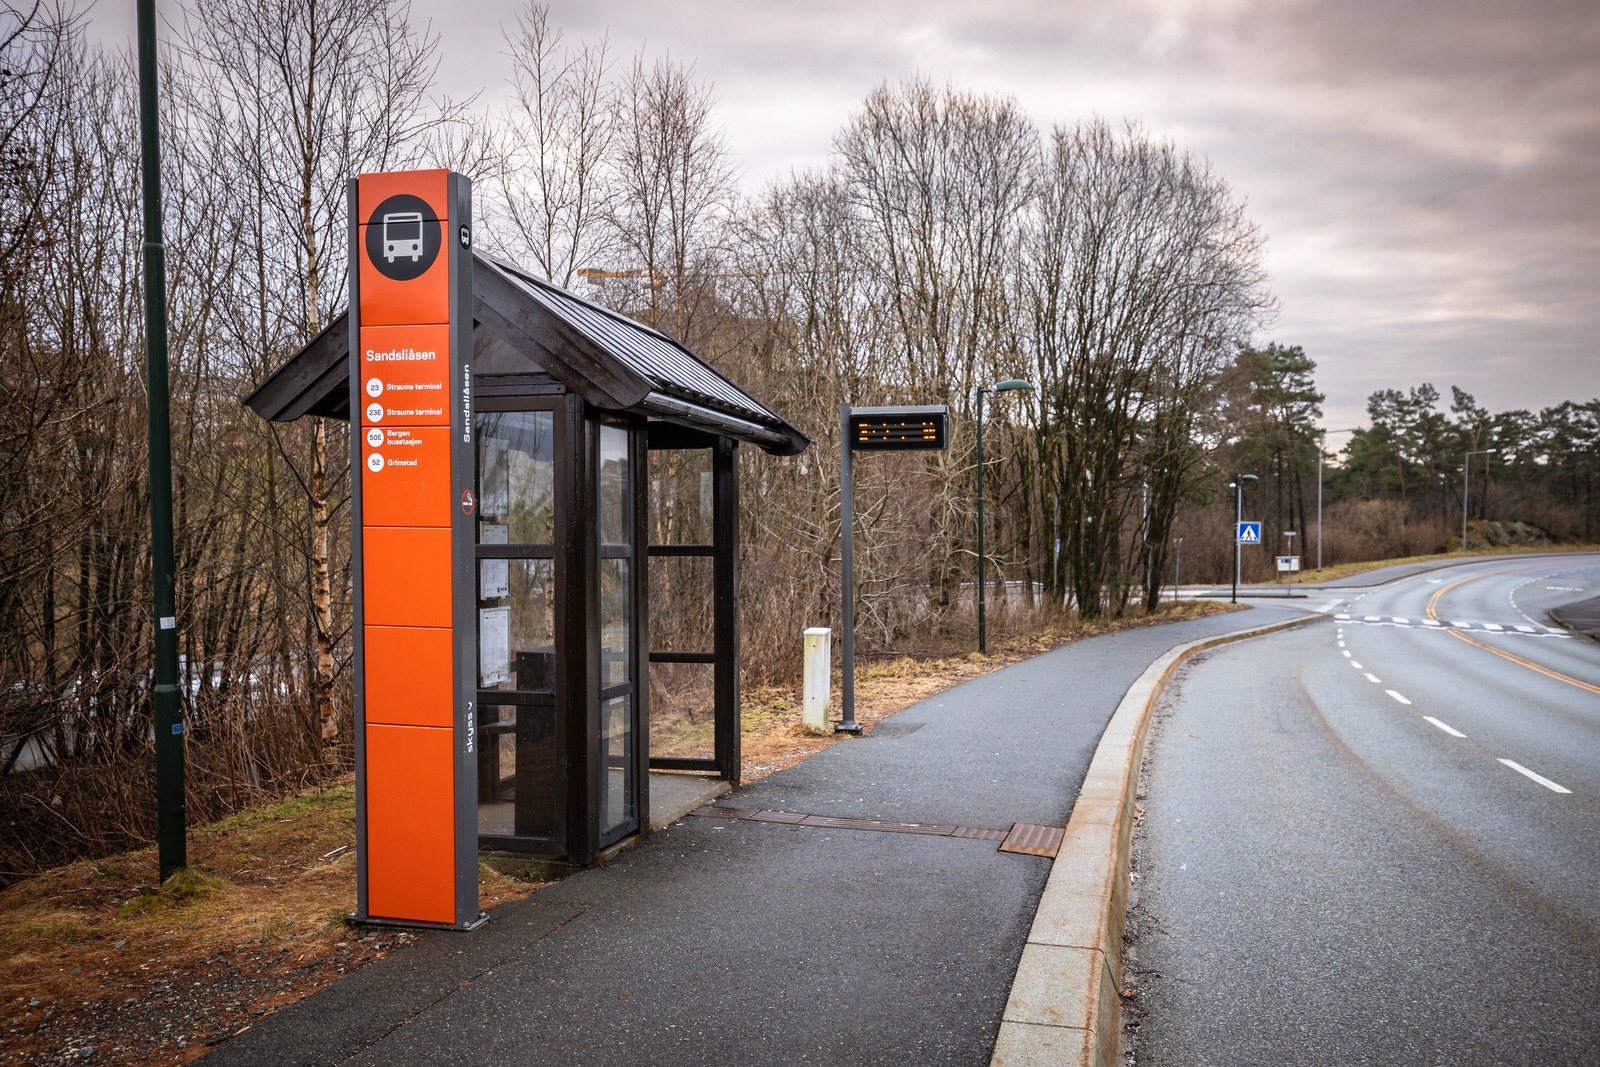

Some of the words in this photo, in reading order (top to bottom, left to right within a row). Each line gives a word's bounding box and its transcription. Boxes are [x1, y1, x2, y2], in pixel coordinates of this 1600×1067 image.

[366, 349, 436, 361] Sandsliåsen
[415, 382, 442, 390] terminal
[415, 407, 443, 415] terminal
[387, 430, 410, 438] Bergen
[387, 438, 422, 446] busstasjon
